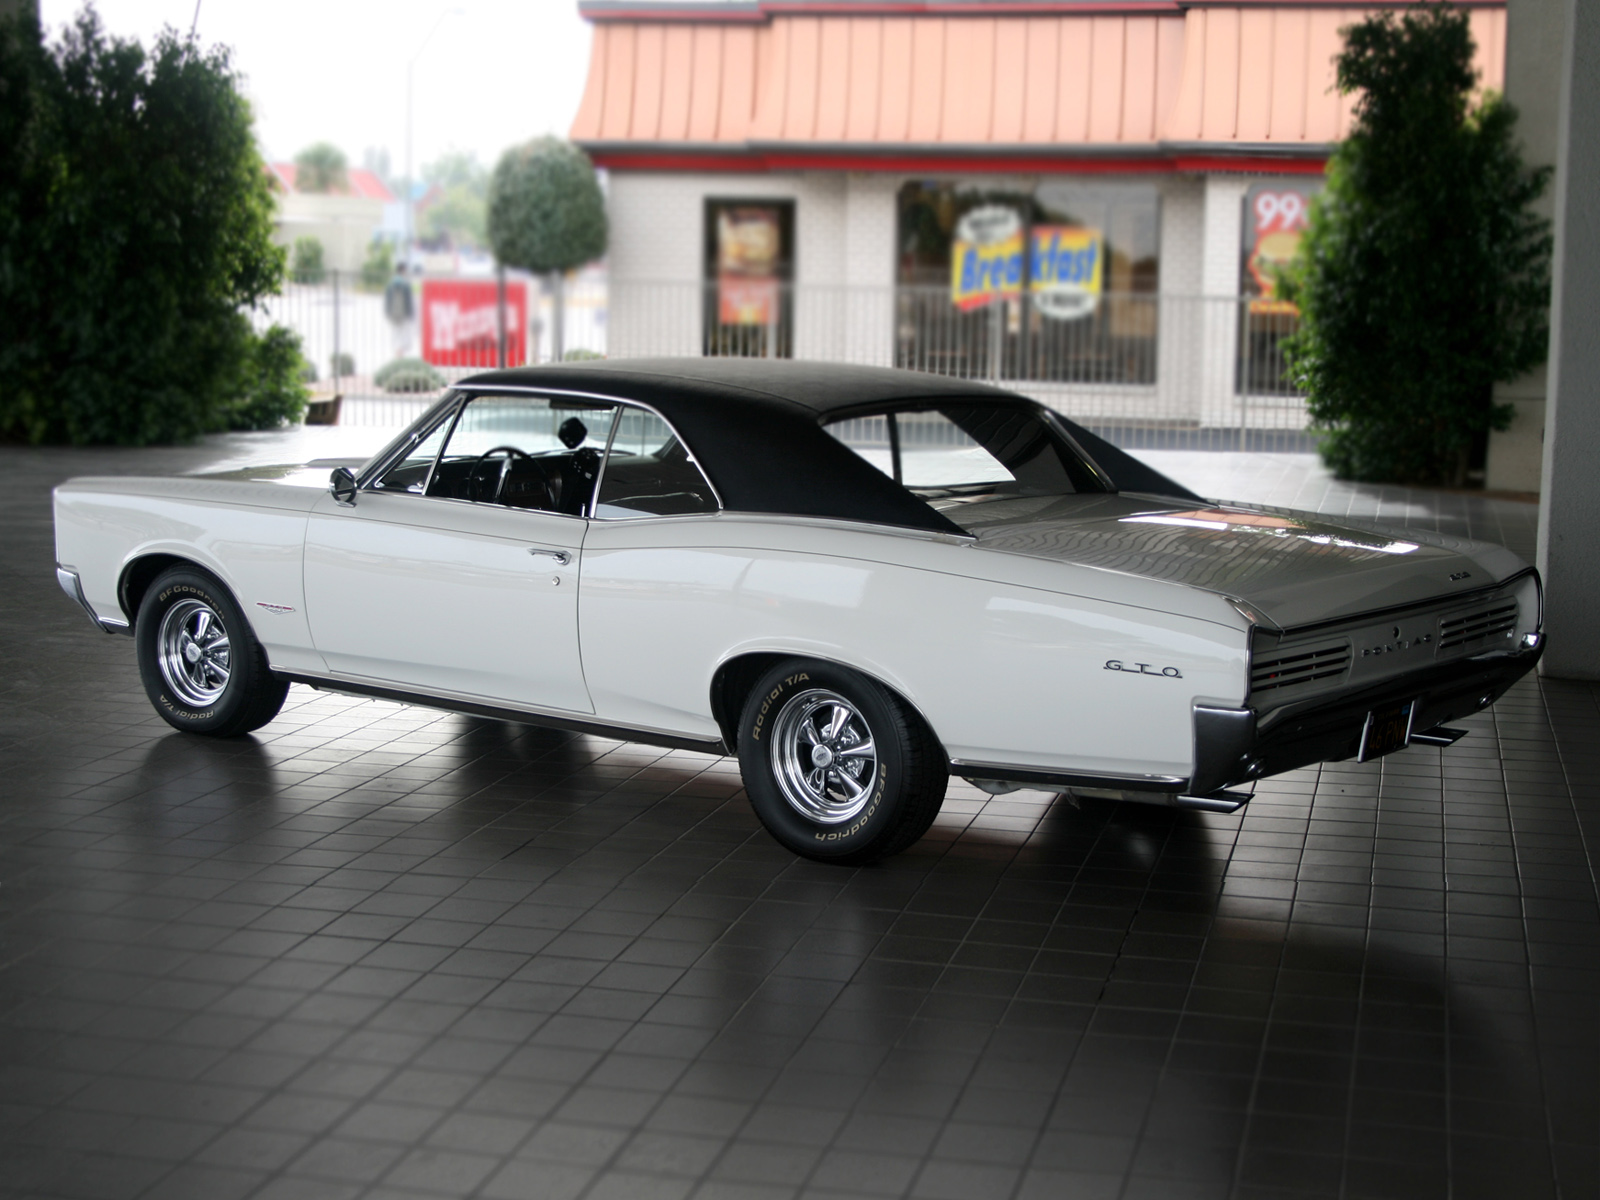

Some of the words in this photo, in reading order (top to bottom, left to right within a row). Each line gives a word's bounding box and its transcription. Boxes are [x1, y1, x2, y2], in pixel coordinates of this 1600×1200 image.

[961, 231, 1097, 293] Breakfast
[1361, 633, 1432, 658] PONTIAC
[1103, 659, 1183, 678] GTO
[158, 694, 176, 711] T/A
[176, 708, 215, 721] Radial
[751, 683, 783, 741] Radial
[785, 672, 810, 687] T/A
[814, 763, 887, 842] BFGoodrich
